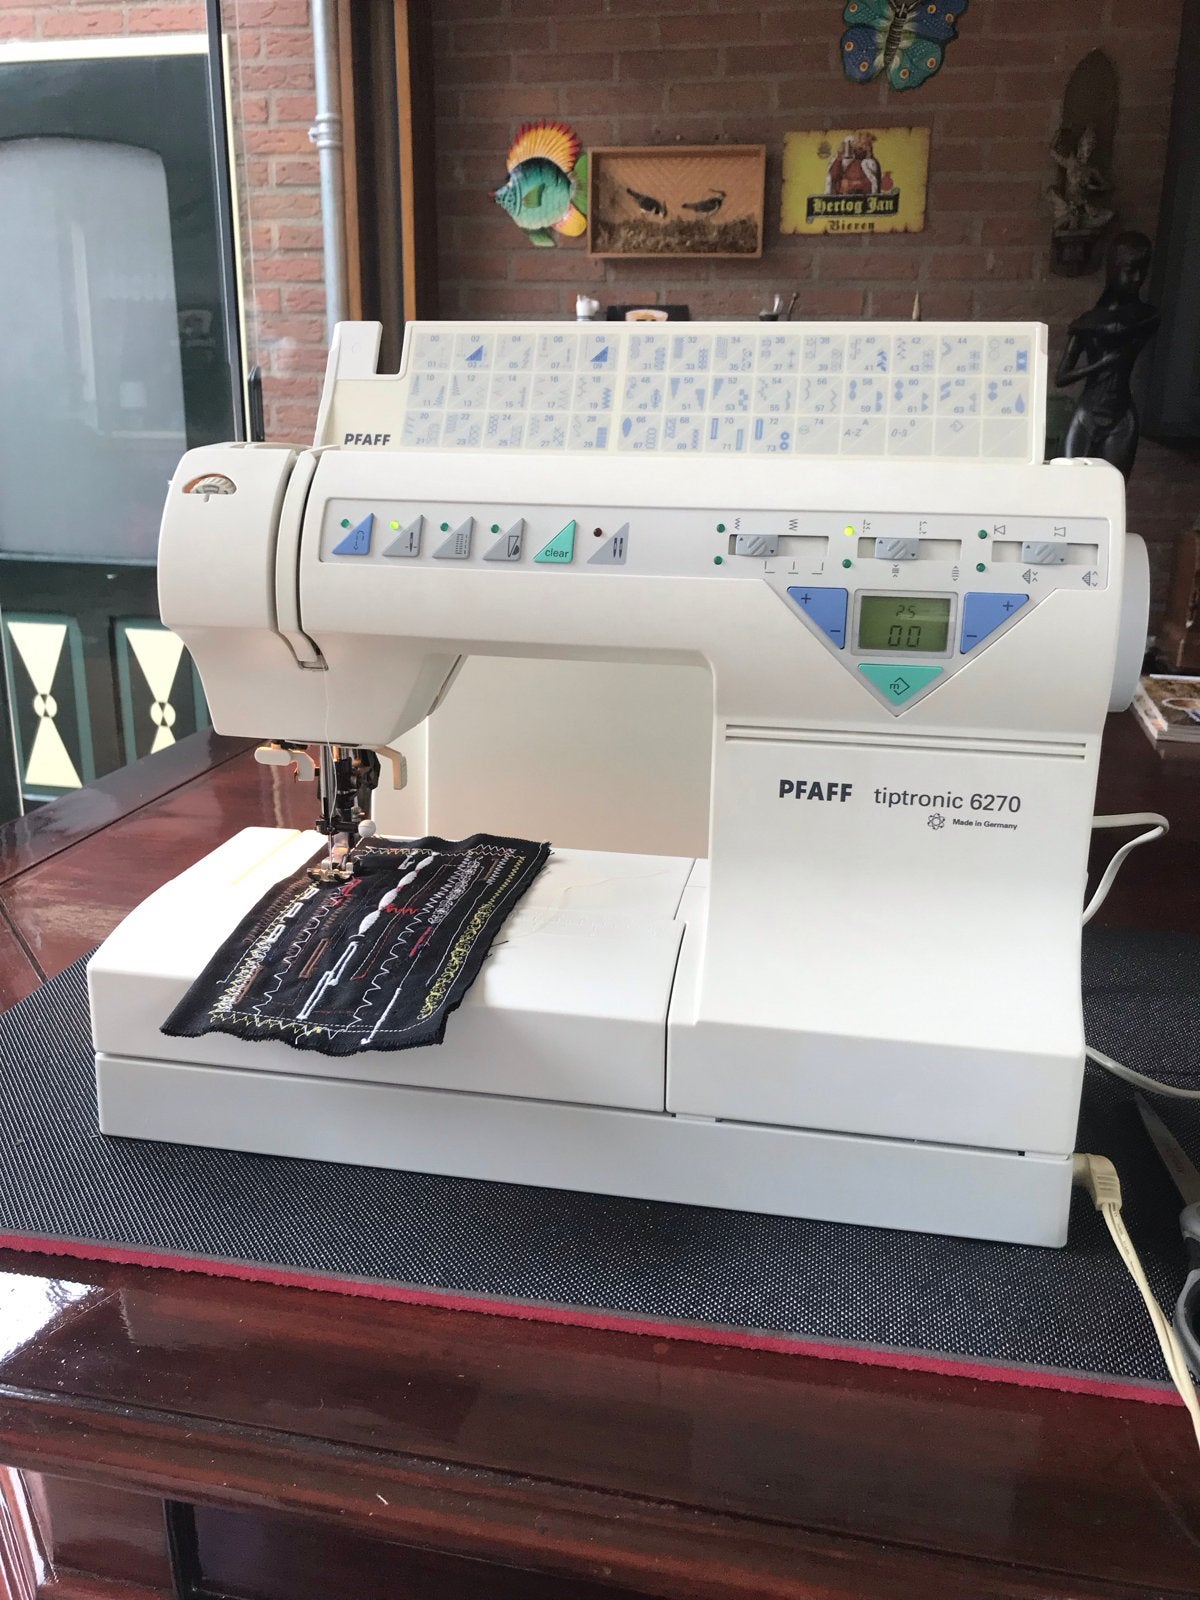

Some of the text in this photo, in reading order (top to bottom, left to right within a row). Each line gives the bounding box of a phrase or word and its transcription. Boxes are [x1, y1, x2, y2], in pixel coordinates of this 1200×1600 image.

[813, 197, 894, 213] Hertog Jan
[828, 220, 876, 231] Bieren
[344, 433, 391, 446] PFAFF
[545, 548, 569, 558] clear
[888, 625, 922, 647] 00
[779, 779, 853, 802] PFAFF
[874, 787, 1021, 812] tiptronic 6270
[952, 818, 1018, 831] Made in Germany
